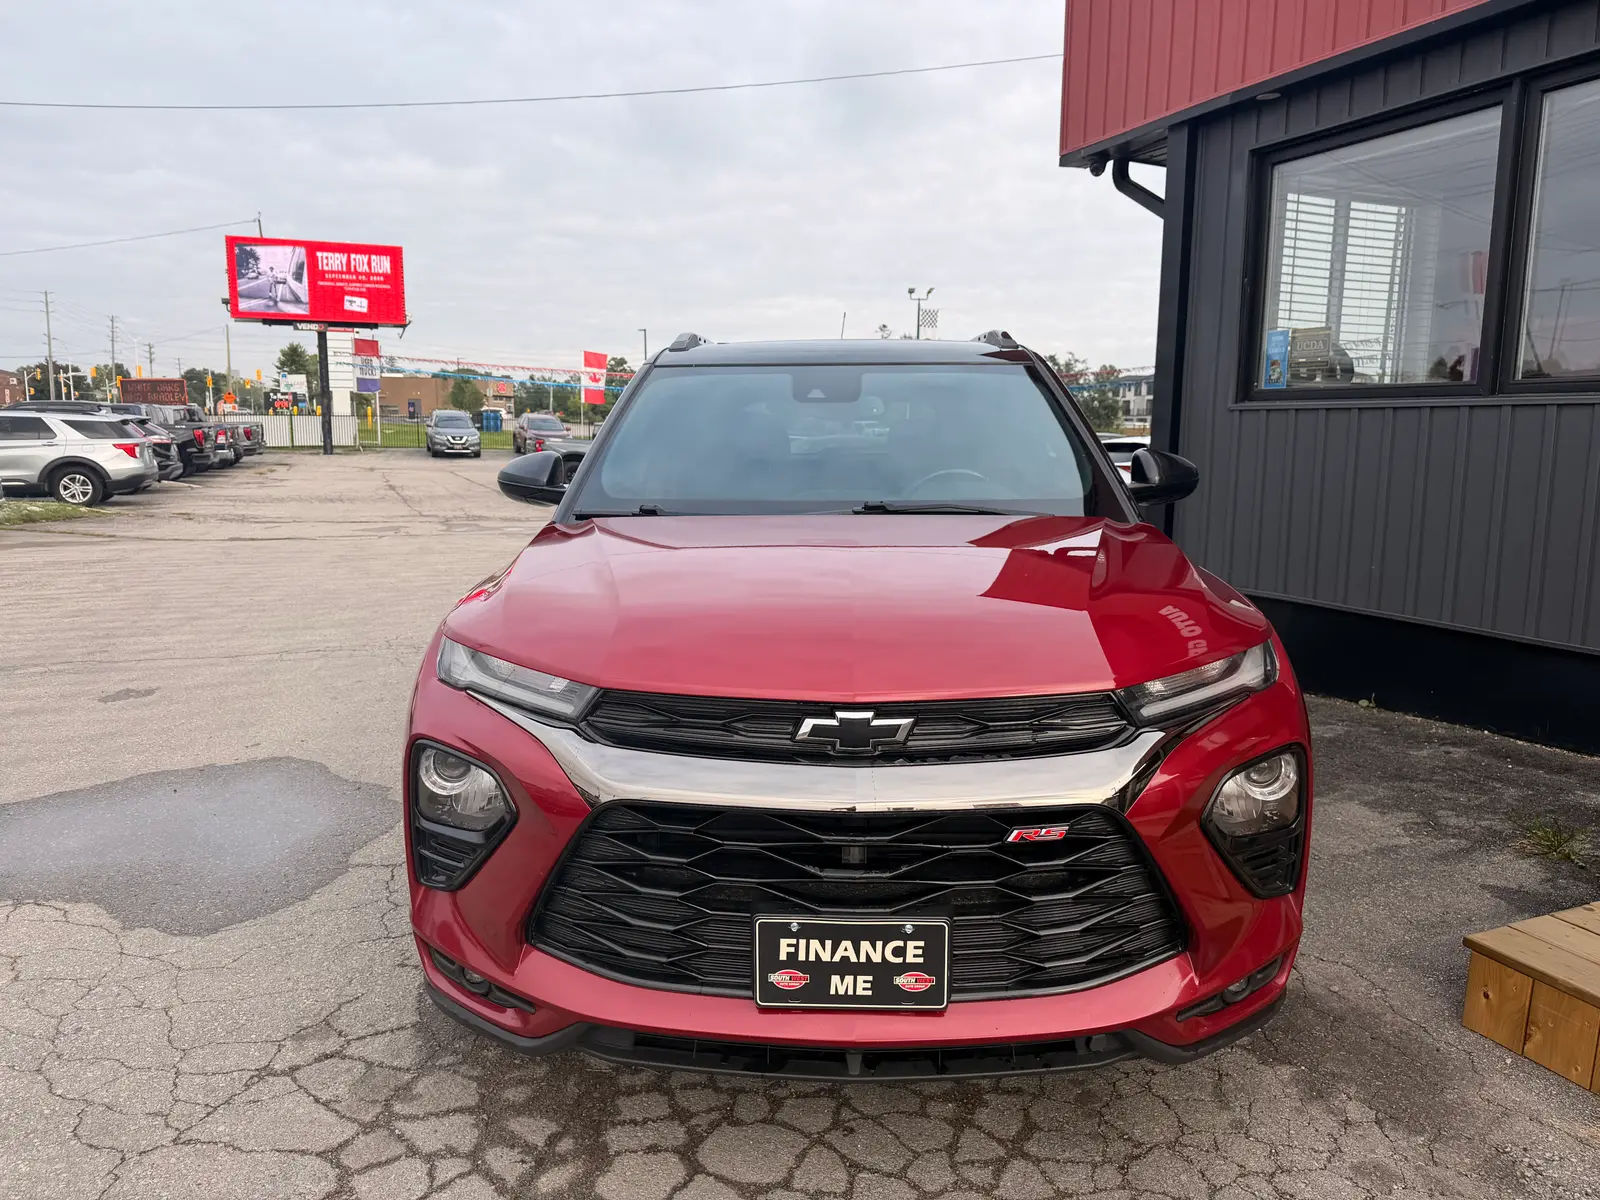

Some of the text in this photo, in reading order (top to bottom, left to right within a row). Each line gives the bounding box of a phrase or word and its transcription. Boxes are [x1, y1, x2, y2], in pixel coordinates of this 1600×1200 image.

[316, 251, 391, 274] TERRY FOX RUN
[296, 322, 325, 331] VENDO
[1296, 340, 1324, 351] UCDA
[127, 383, 180, 392] WHITE OAKS
[147, 392, 186, 401] BRADLEY
[275, 399, 289, 409] OPEN
[1006, 826, 1069, 842] RS
[779, 938, 925, 963] FINANCE
[829, 975, 873, 995] ME
